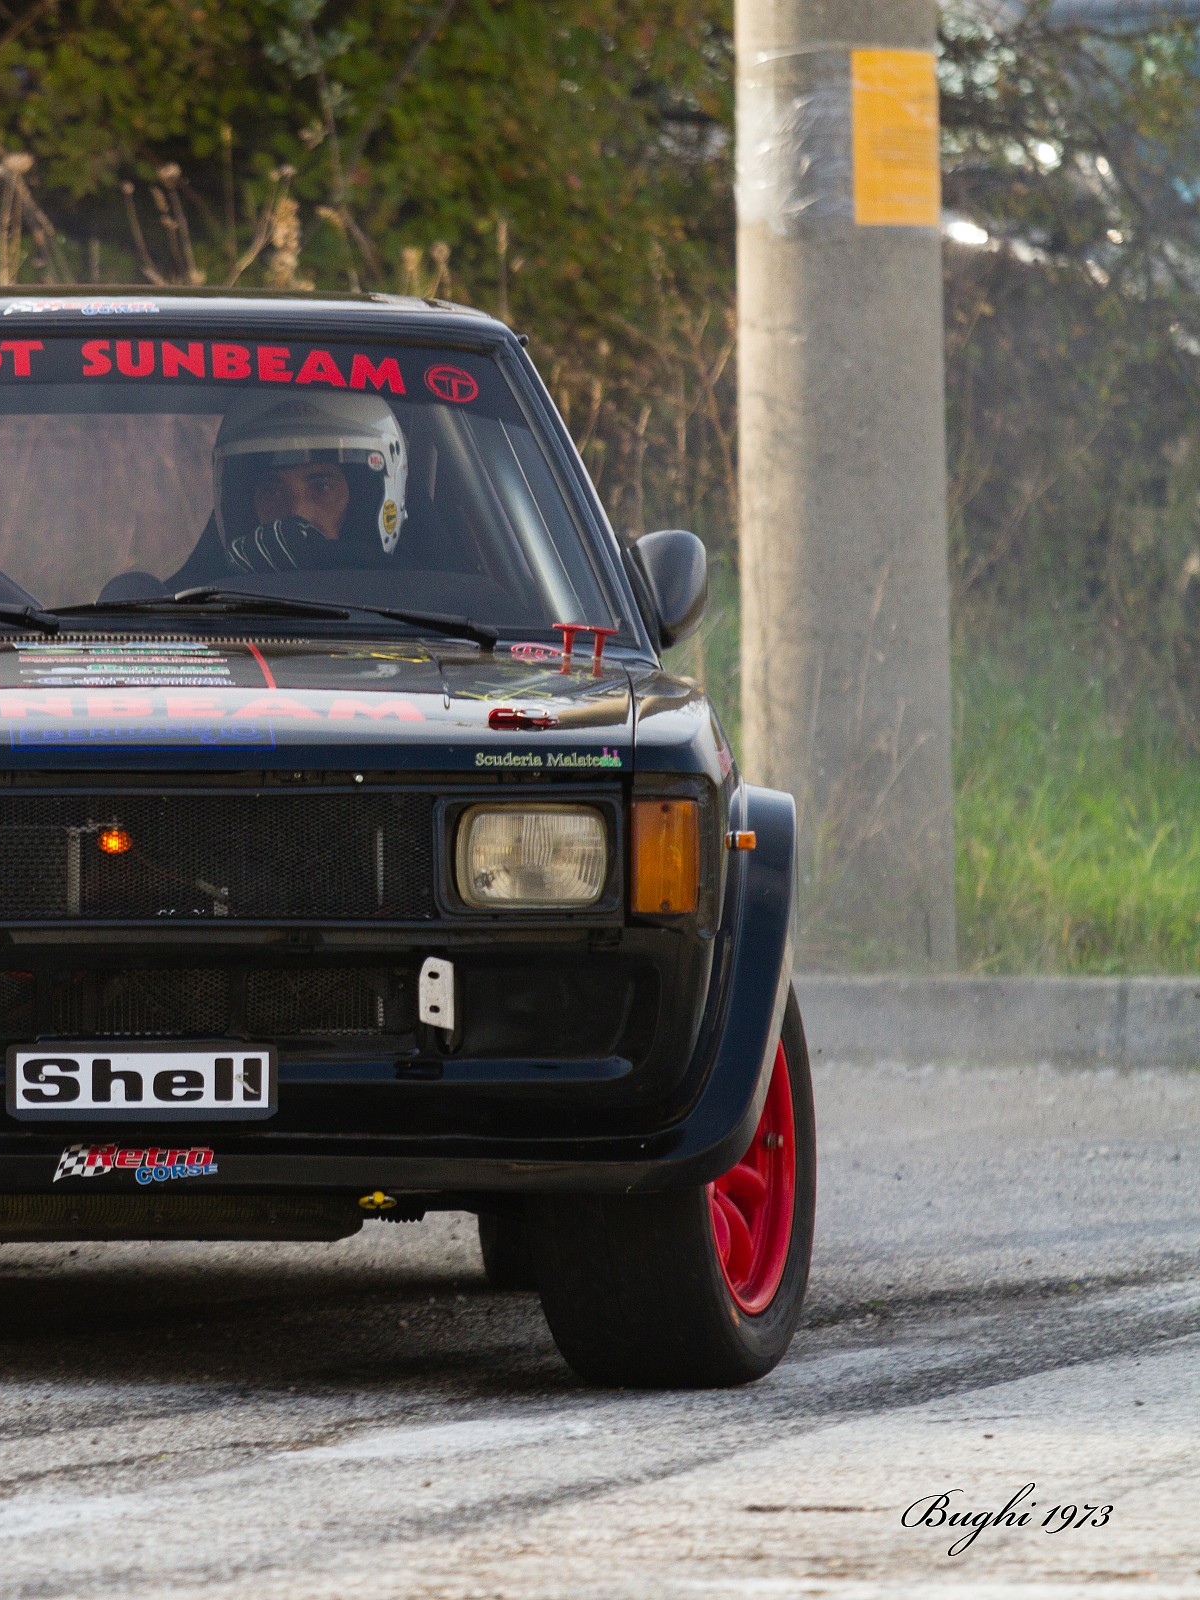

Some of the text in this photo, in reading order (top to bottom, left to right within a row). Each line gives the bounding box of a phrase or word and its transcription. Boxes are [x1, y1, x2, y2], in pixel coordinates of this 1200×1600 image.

[81, 339, 407, 395] SUNBEAM
[475, 752, 543, 768] Scuderia
[21, 1057, 263, 1104] Shell
[134, 1163, 219, 1185] CORSE
